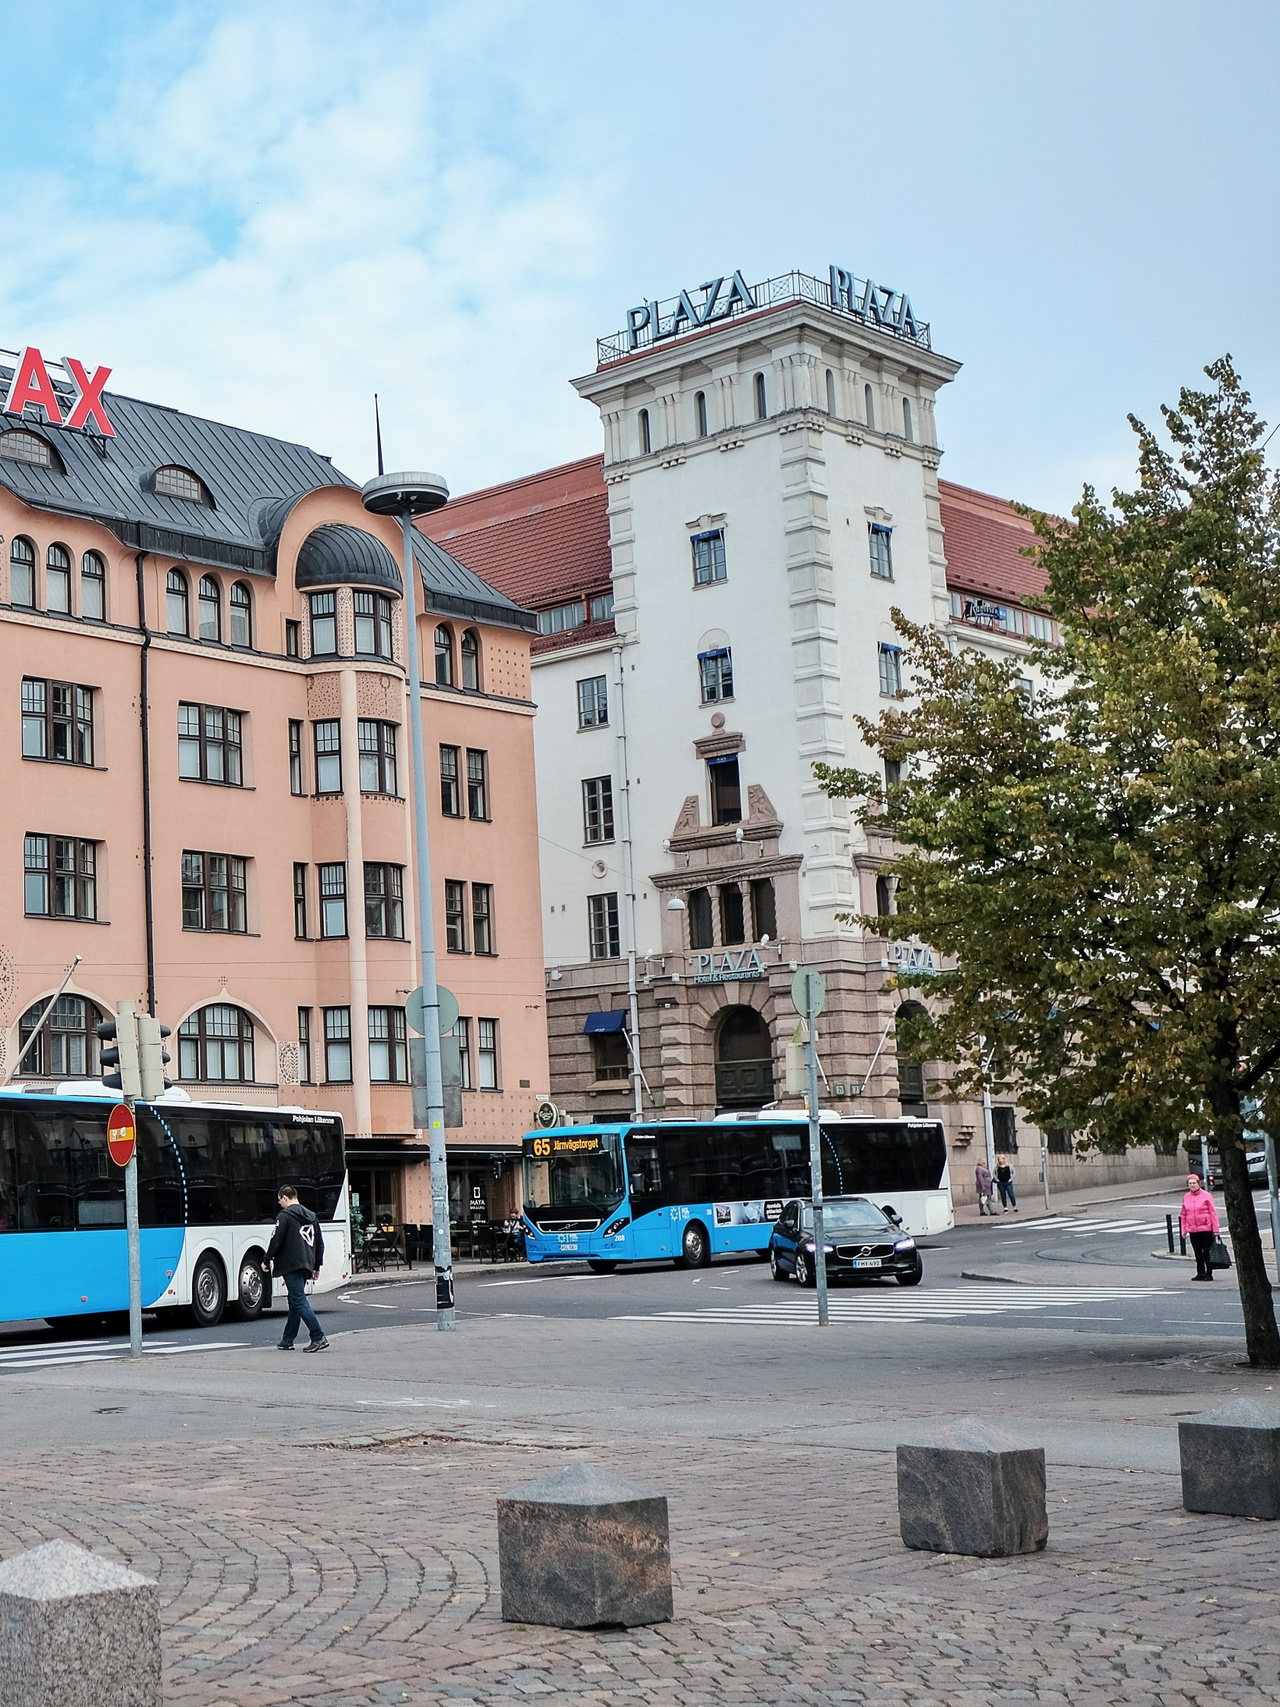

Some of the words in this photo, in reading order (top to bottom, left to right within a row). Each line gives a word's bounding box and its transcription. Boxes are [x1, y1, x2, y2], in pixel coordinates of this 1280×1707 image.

[627, 269, 756, 350] PLAZA
[829, 264, 920, 336] PLAZA
[698, 948, 761, 974] PLAZA
[694, 973, 712, 983] Hotel
[720, 970, 760, 981] Restaurants
[534, 1139, 551, 1156] 65
